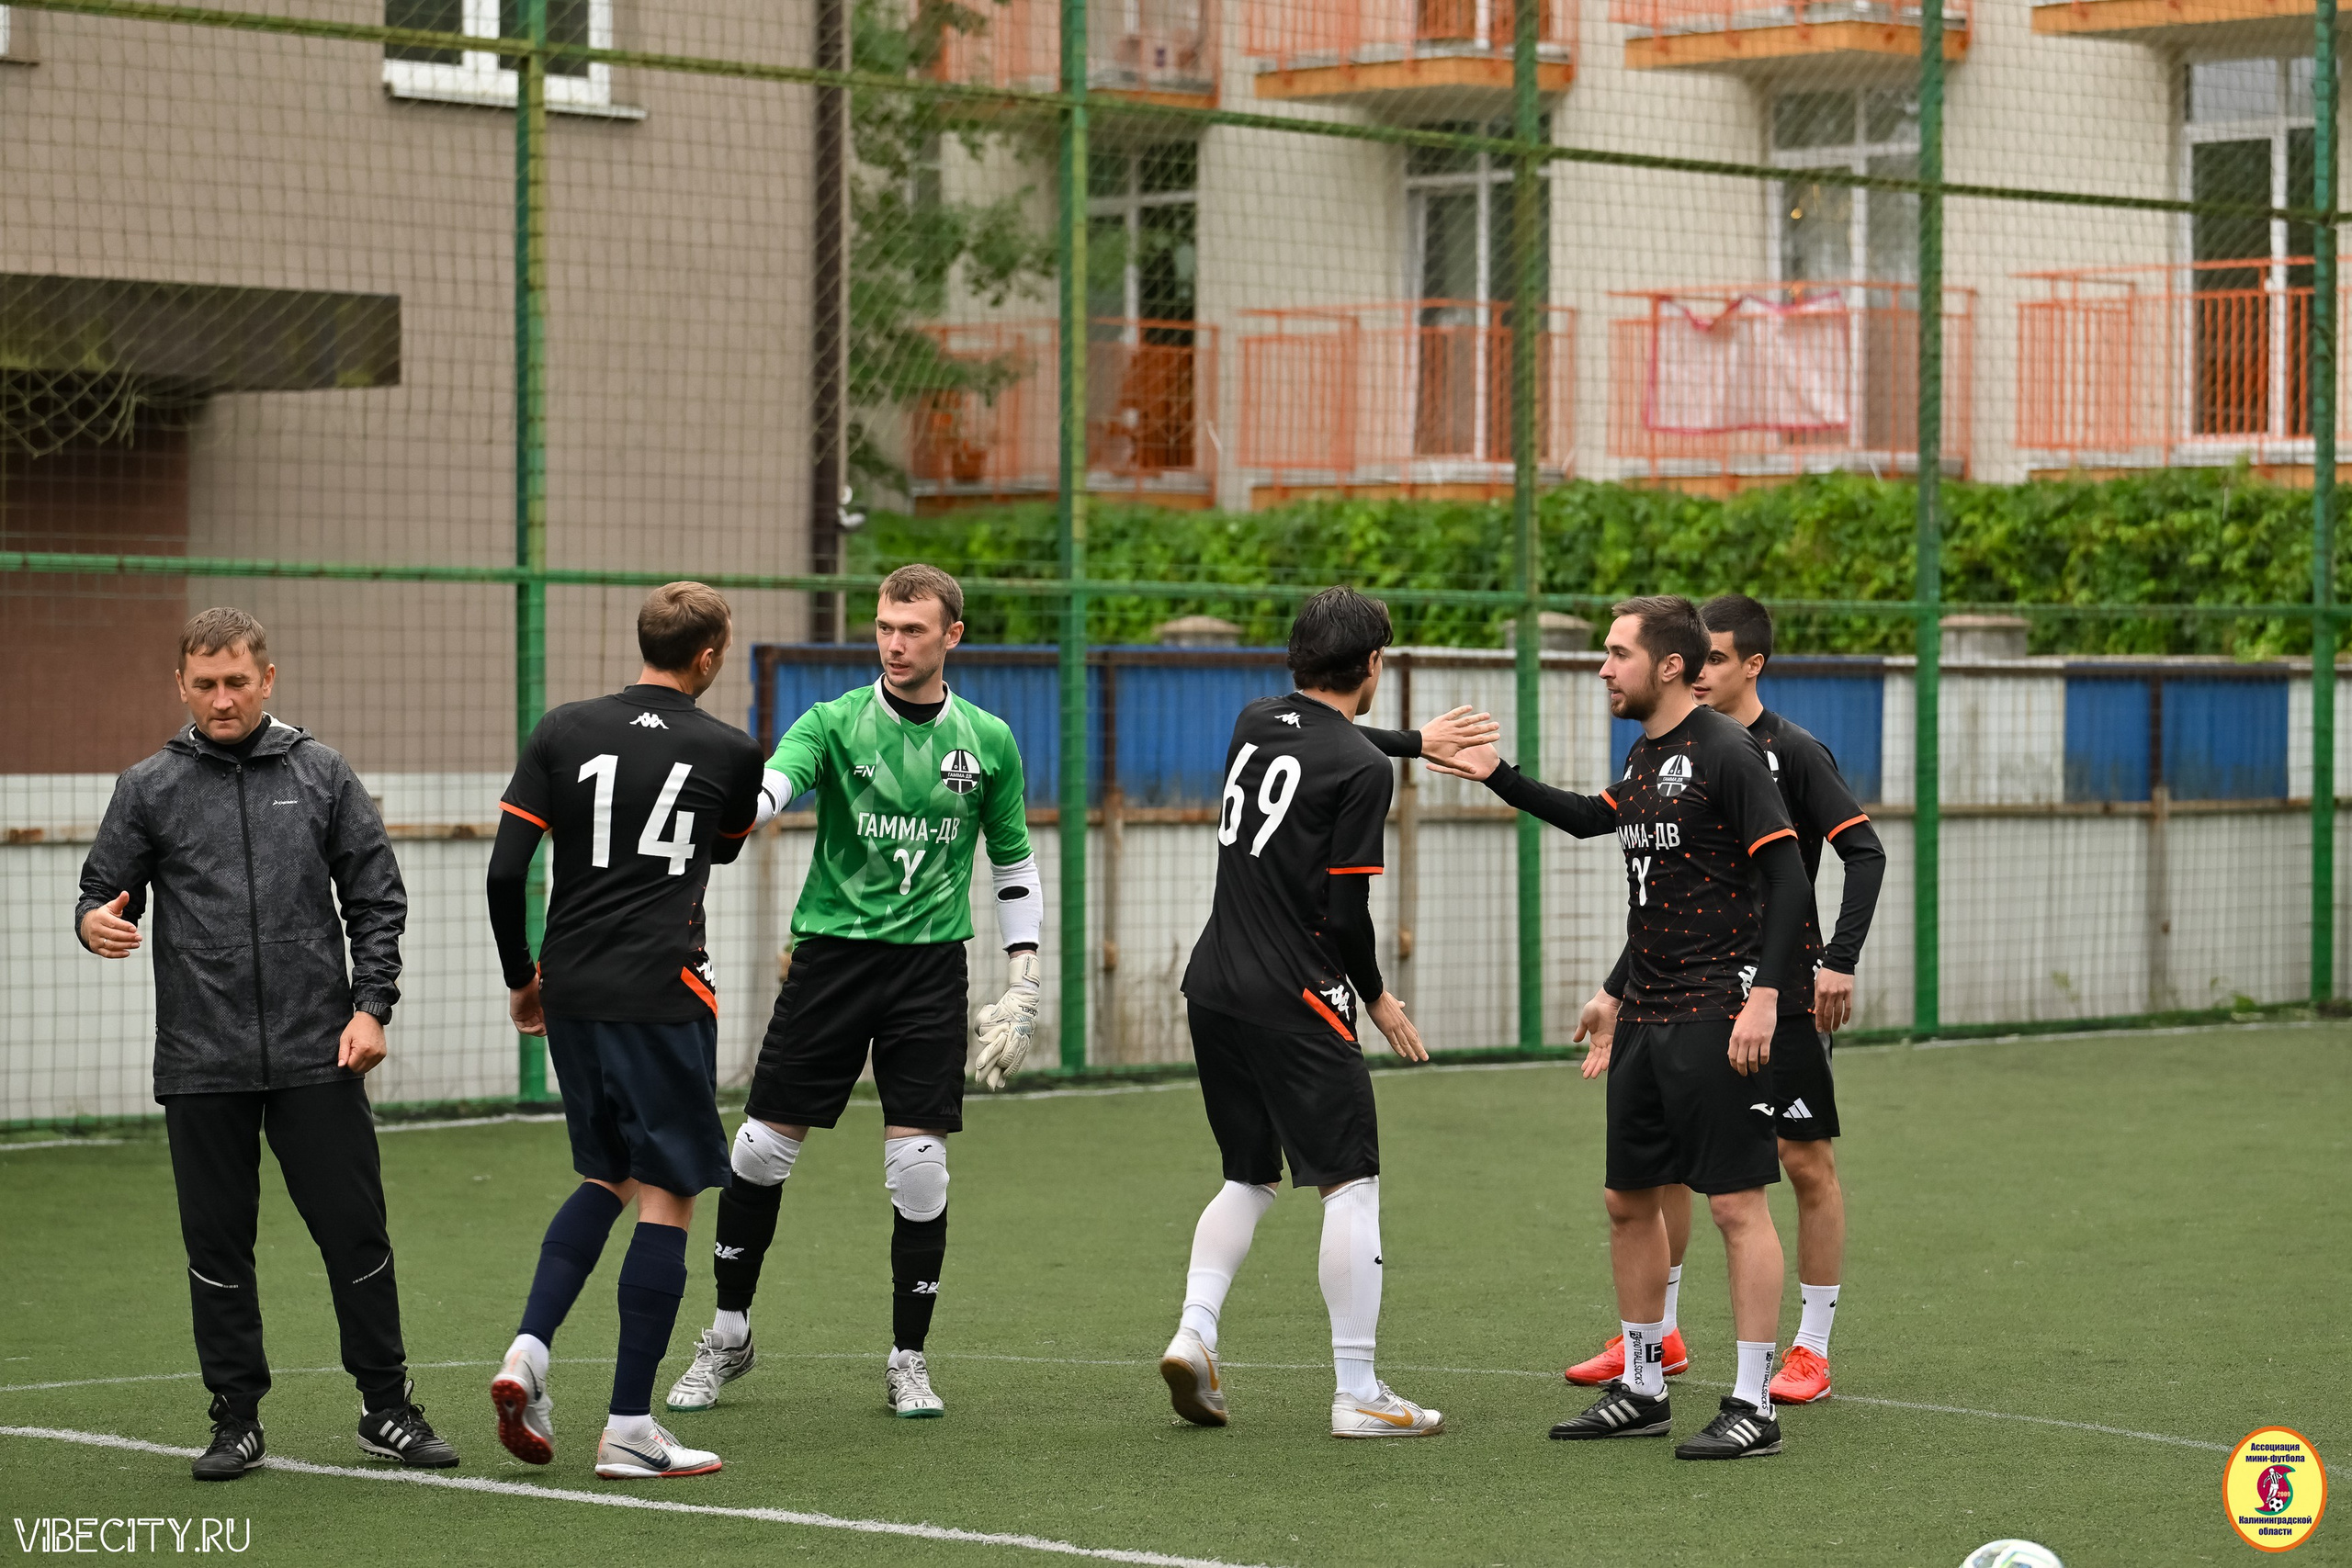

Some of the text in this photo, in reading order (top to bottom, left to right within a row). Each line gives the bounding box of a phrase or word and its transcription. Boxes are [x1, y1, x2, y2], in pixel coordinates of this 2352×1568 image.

[577, 754, 695, 875] 14
[856, 812, 961, 844] ГАММА-ДВ
[1218, 742, 1301, 858] 69
